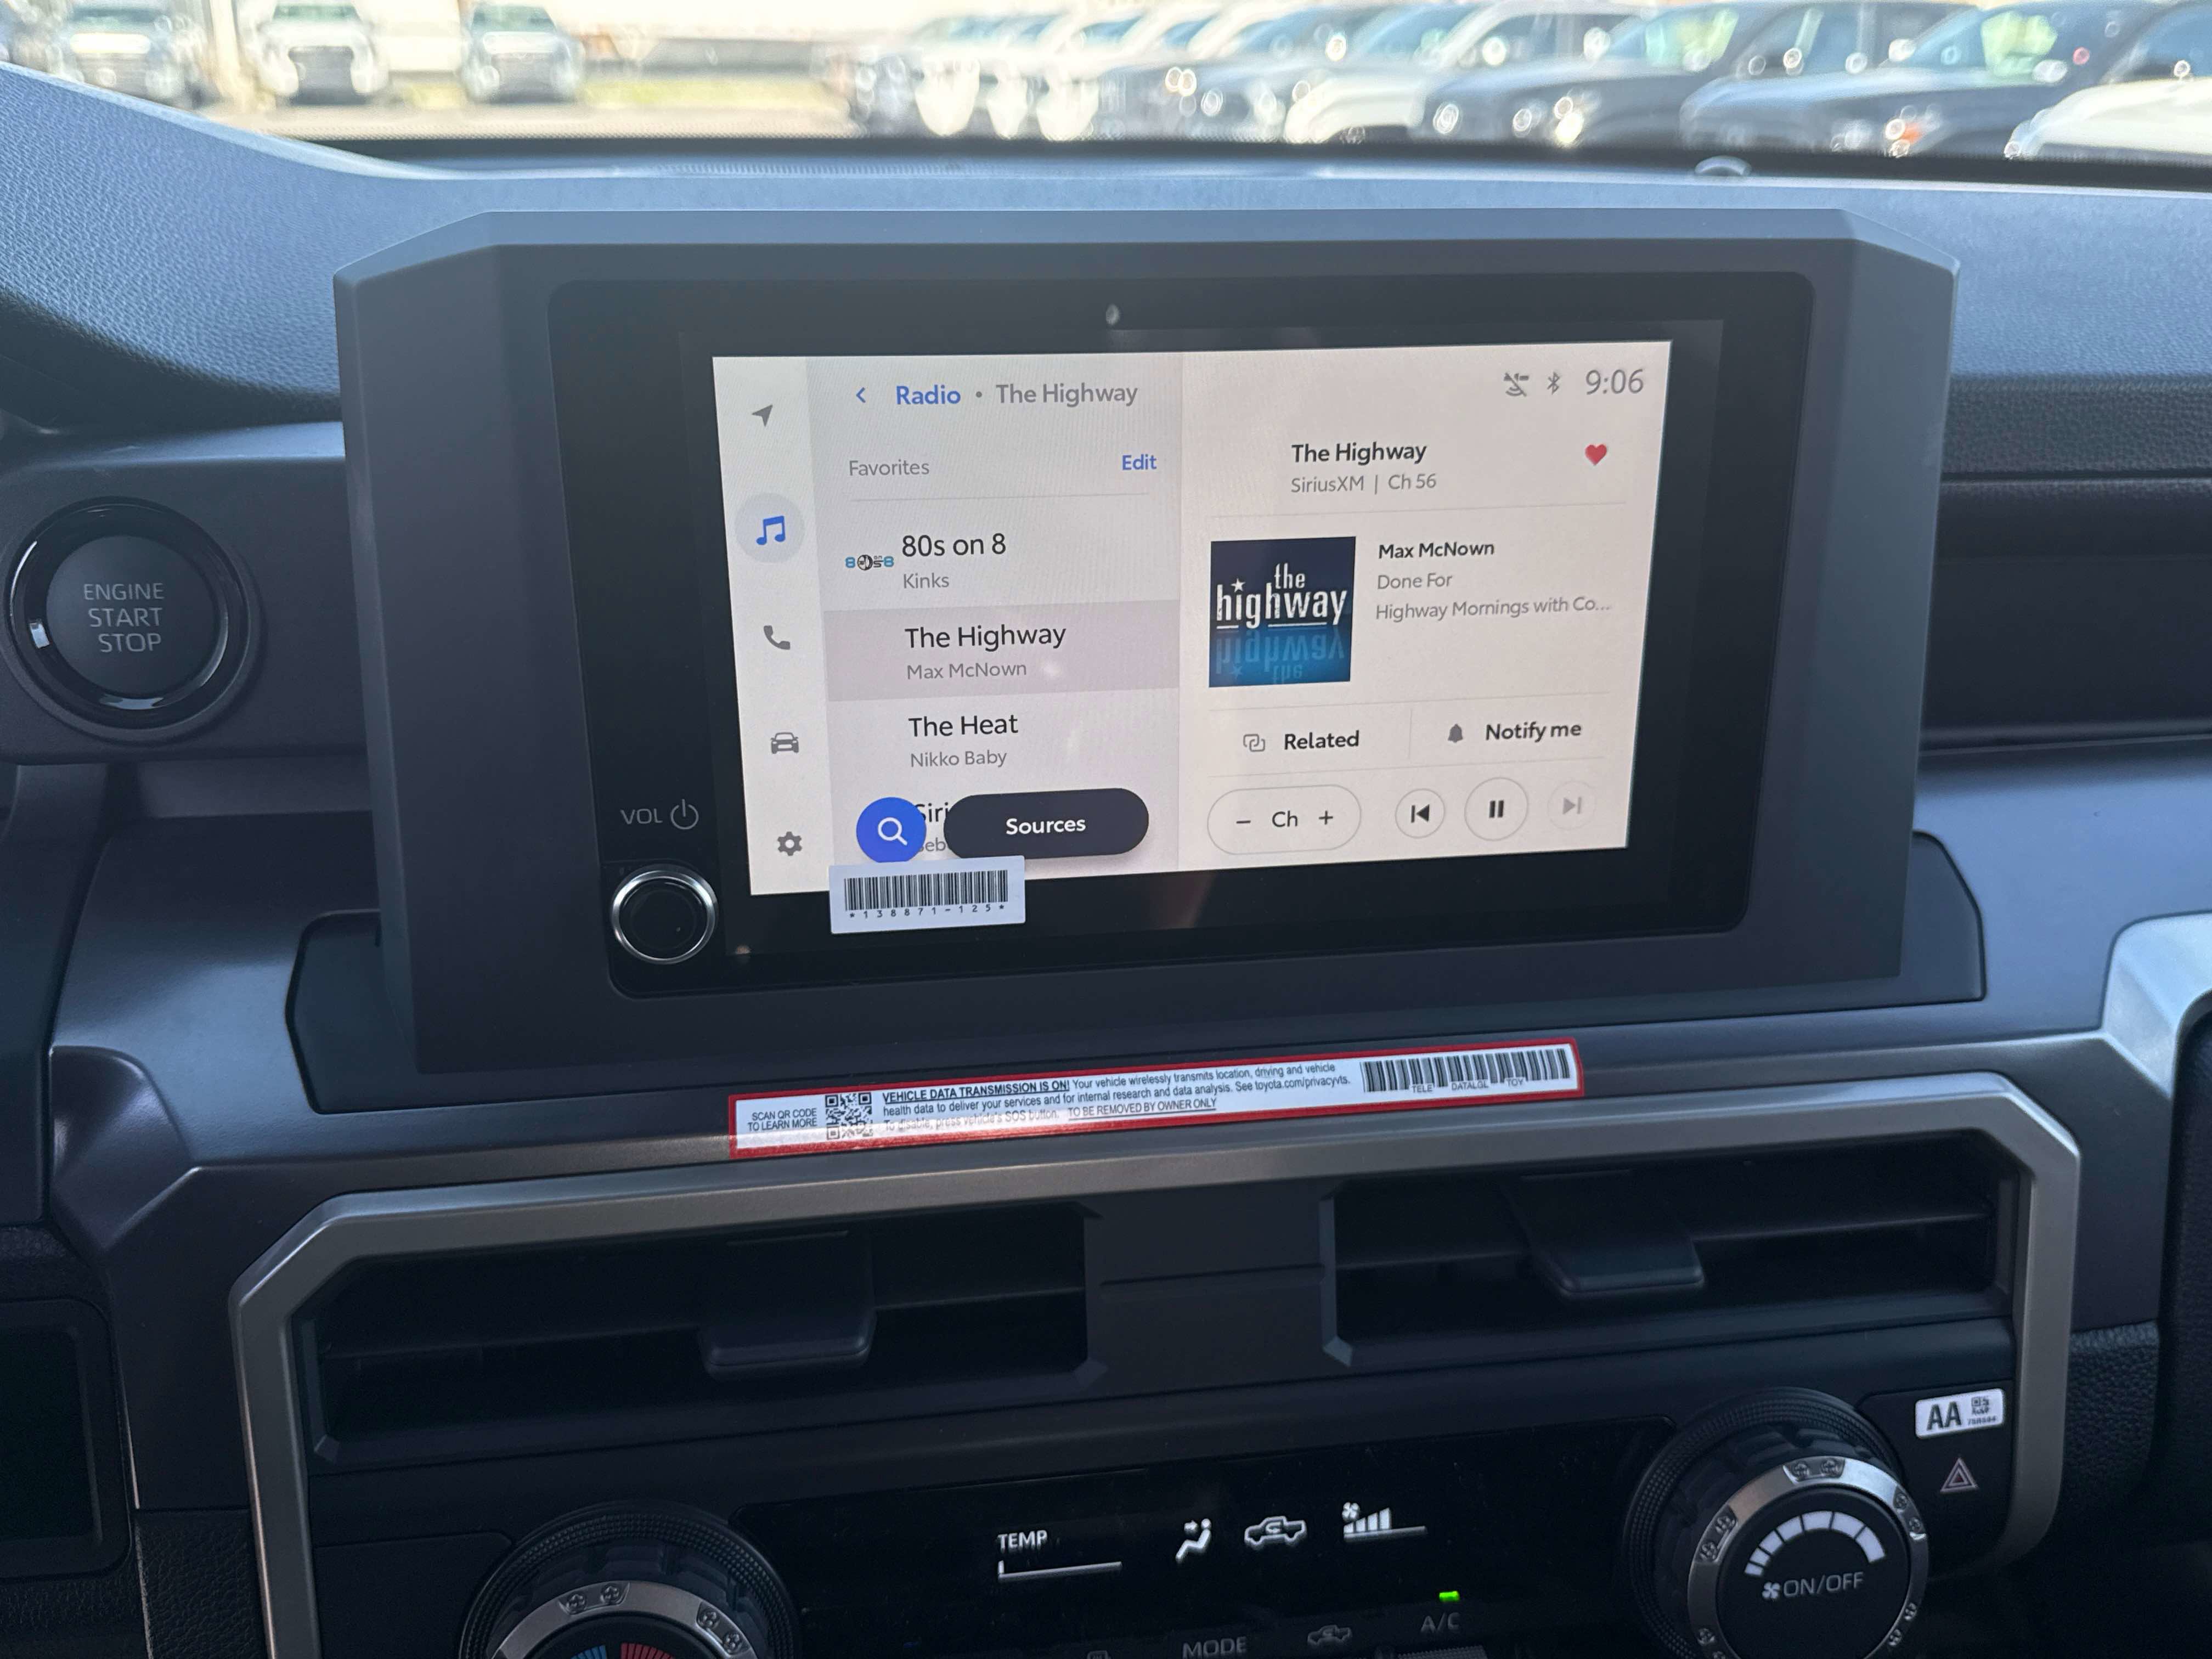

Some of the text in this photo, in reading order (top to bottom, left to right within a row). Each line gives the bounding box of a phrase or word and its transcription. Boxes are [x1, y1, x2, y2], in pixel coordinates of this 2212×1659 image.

[1585, 369, 1644, 395] 9:06
[896, 382, 1138, 407] Radio The Highway
[1121, 455, 1157, 471] Edit
[1291, 442, 1427, 466] The Highway
[849, 460, 930, 477] Favorites
[1291, 476, 1364, 494] SiriusXM
[1388, 474, 1412, 491] Ch
[1415, 473, 1437, 489] 56
[902, 533, 1007, 557] 80s on 8
[1379, 541, 1494, 560] Max McNown
[903, 573, 950, 589] Kinks
[1274, 562, 1305, 589] the
[1378, 572, 1452, 590] Done For
[83, 583, 164, 600] ENGINE
[1217, 582, 1347, 629] highway
[1376, 602, 1448, 623] Highway
[1453, 600, 1529, 620] Mornings
[1533, 597, 1568, 613] with
[88, 608, 162, 627] START
[98, 633, 161, 653] STOP
[905, 624, 1066, 652] The Highway
[907, 662, 1027, 680] Max McNown
[908, 714, 1018, 737] The Heat
[1485, 722, 1582, 743] Notify me
[1284, 730, 1359, 750] Related
[911, 750, 1007, 768] Nikko Baby
[620, 808, 663, 825] VOL
[1006, 817, 1086, 835] Sources
[1272, 810, 1299, 828] Ch
[882, 1063, 1335, 1103] VEHICLE DATA TRANSMISSION IS ON! Your vehicle wirelessly transmits location, driving and vehicle
[1412, 1084, 1432, 1093] TELE
[883, 1105, 911, 1116] health
[915, 1103, 933, 1114] data
[938, 1103, 946, 1113] to
[950, 1100, 978, 1111] deliver
[982, 1100, 1001, 1112] your
[1005, 1097, 1041, 1108] services
[1044, 1094, 1060, 1104] and
[1063, 1093, 1075, 1103] for
[1078, 1090, 1110, 1102] internal
[1113, 1088, 1151, 1099] research
[1154, 1087, 1170, 1097] and
[1173, 1085, 1192, 1096] data
[1235, 1081, 1252, 1092] See
[1069, 1107, 1080, 1117] TO
[1083, 1106, 1094, 1116] BE
[1097, 1102, 1142, 1115] REMOVED
[1144, 1102, 1155, 1111] BY
[1158, 1099, 1192, 1111] OWNER
[1193, 1098, 1216, 1108] ONLY
[747, 1118, 817, 1131] TO LEARN MORE
[752, 1108, 817, 1121] SCAN QR CODE
[1927, 1401, 1962, 1431] AA
[998, 1530, 1047, 1550] TEMP
[1783, 1571, 1864, 1597] ON/OFF
[1420, 1613, 1460, 1633] A/C
[1182, 1637, 1247, 1658] MODE
